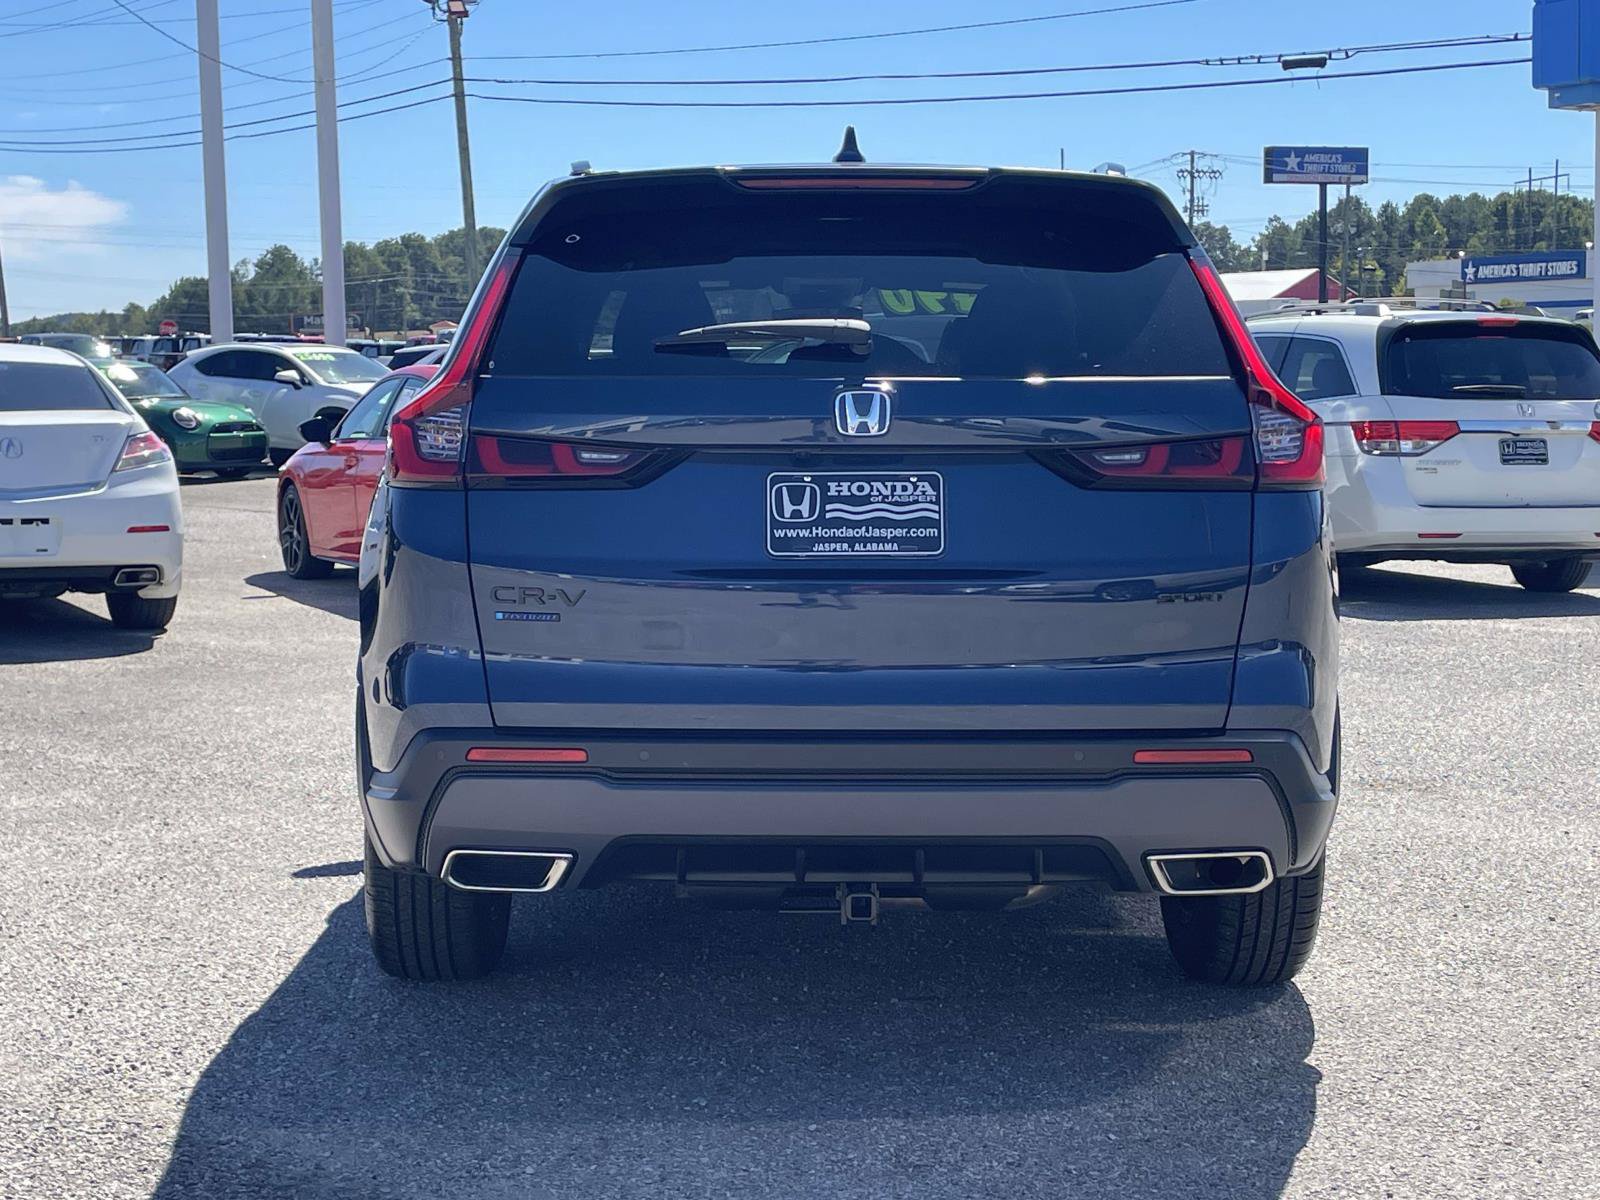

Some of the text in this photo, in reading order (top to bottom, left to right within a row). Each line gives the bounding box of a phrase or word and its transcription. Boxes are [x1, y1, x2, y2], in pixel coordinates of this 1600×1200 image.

[1303, 153, 1342, 163] AMERICA'S
[1303, 163, 1357, 173] THRIFT STORES
[1477, 261, 1578, 278] AMERICA'S THRIFT STORES
[827, 482, 937, 496] HONDA
[773, 526, 938, 539] www.HondaofJasper.com
[812, 543, 899, 552] JASPER, ALABAMA
[491, 585, 586, 607] CR-V
